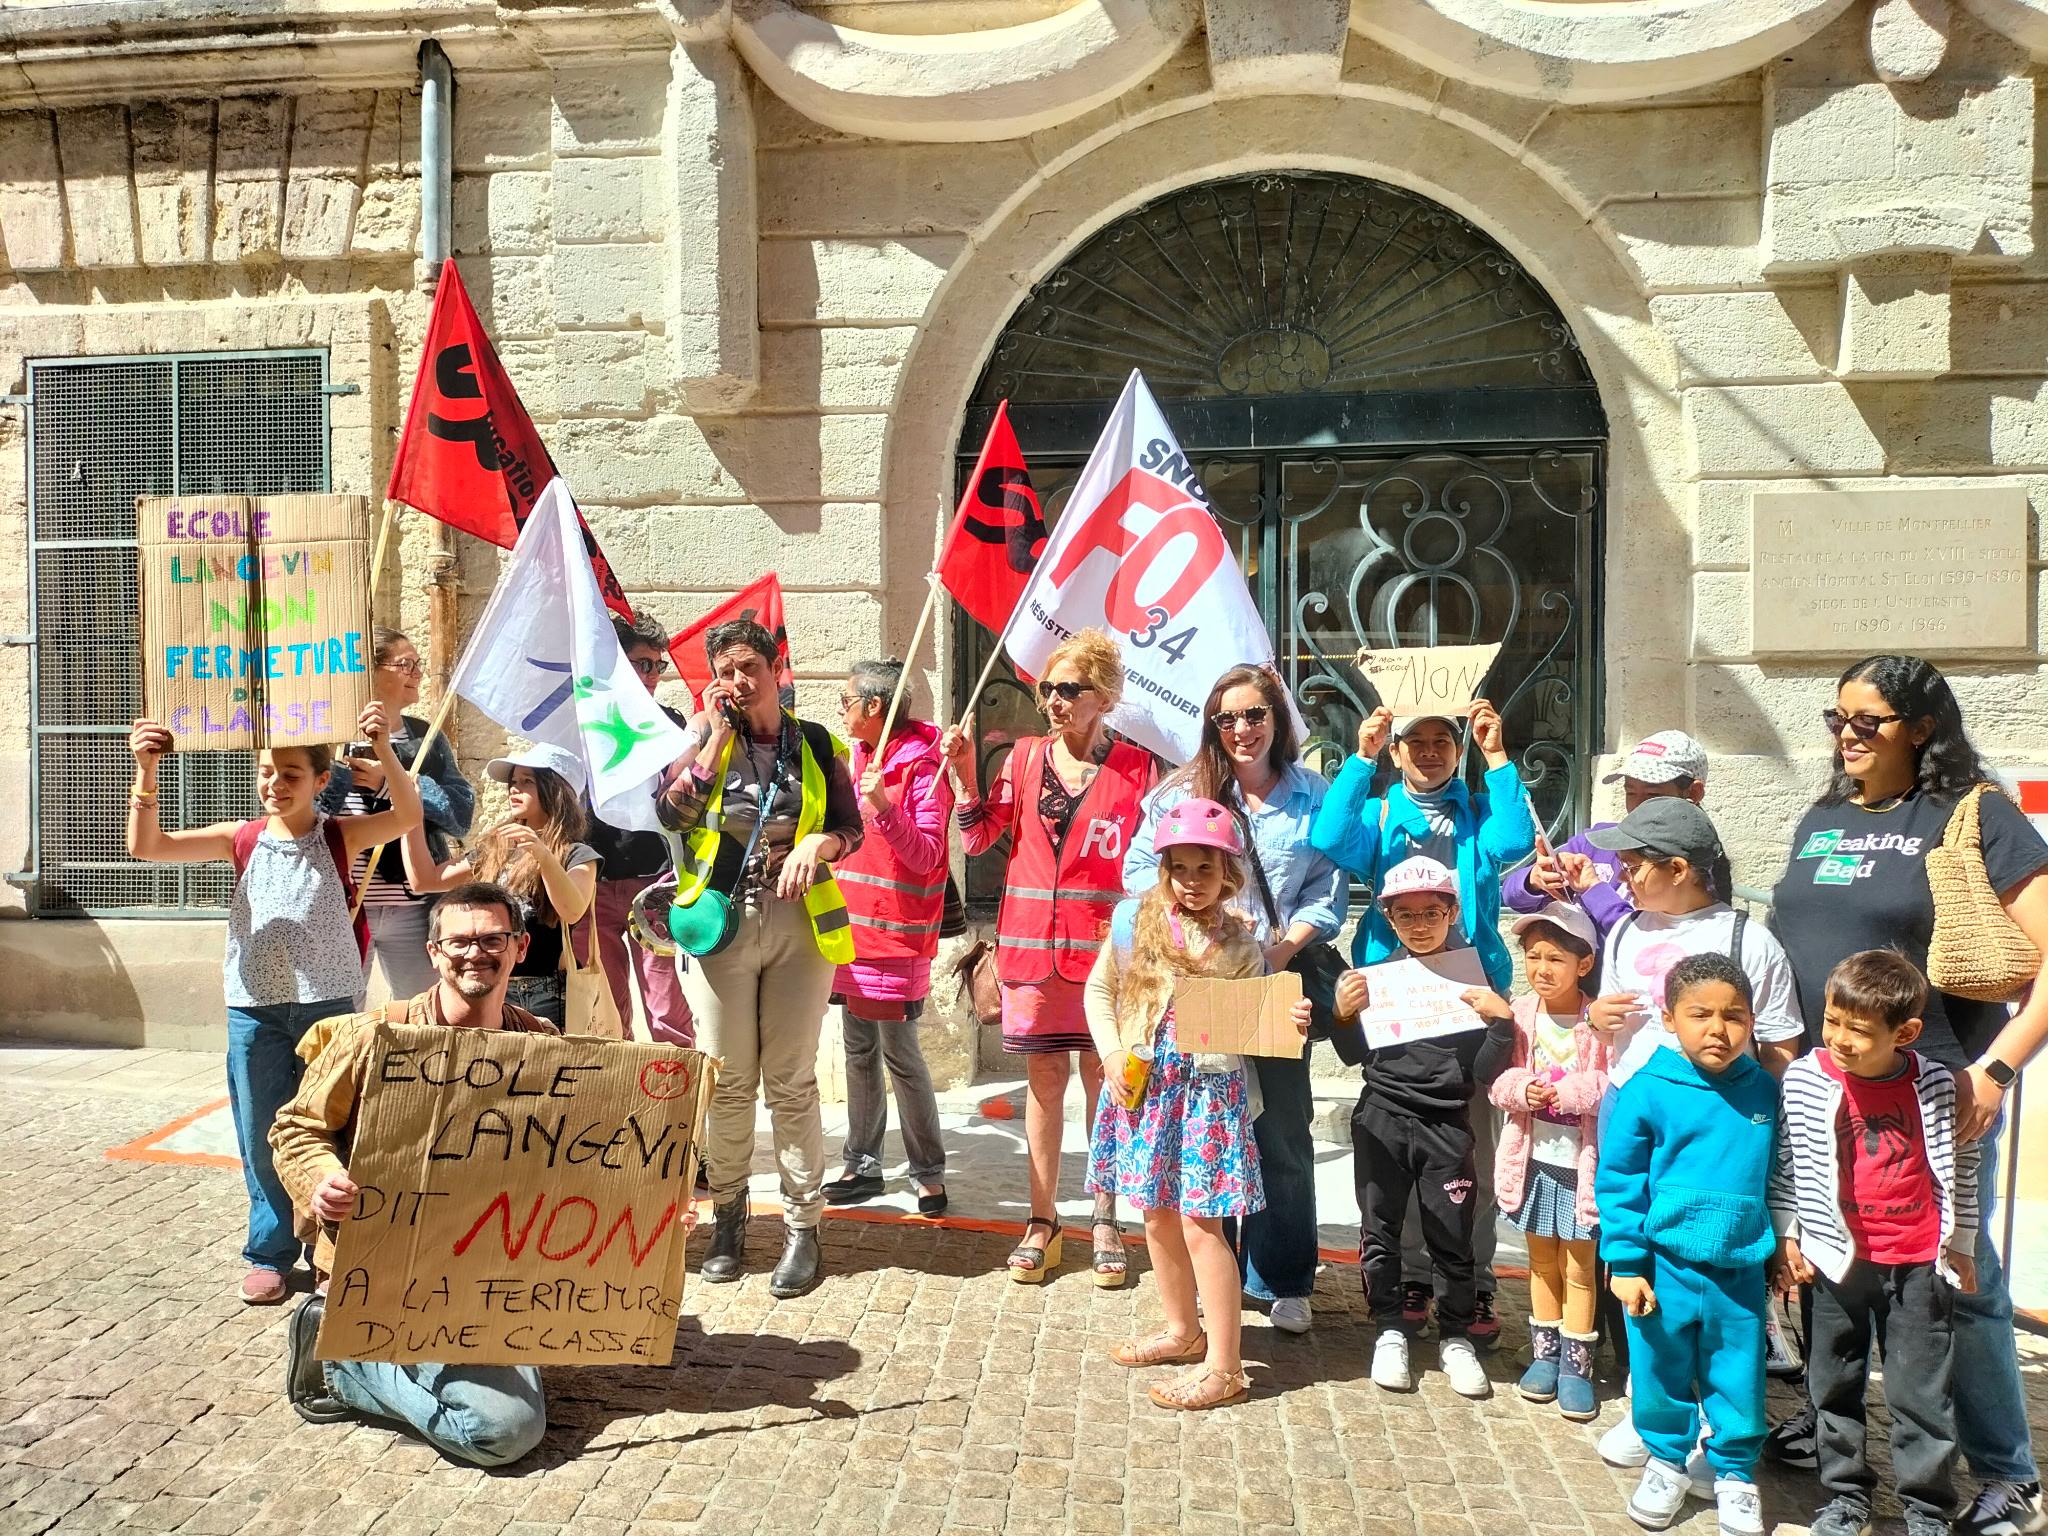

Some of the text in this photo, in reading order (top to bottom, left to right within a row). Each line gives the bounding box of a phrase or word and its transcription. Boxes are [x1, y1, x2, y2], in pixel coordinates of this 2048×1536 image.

[171, 551, 332, 583] LANGEVIN
[1050, 467, 1225, 636] FO
[210, 589, 317, 633] NON
[1029, 598, 1077, 642] RÉSISTE
[166, 632, 366, 679] FERMETURE
[1130, 607, 1199, 665] 34
[1393, 655, 1479, 709] NON
[171, 700, 332, 736] CLASSE
[1080, 818, 1121, 860] FO
[1807, 832, 1923, 856] Breaking
[1819, 860, 1876, 879] Bad
[380, 1048, 601, 1099] ECOLE
[1443, 1179, 1473, 1191] adidas
[352, 1185, 677, 1268] DIT NON
[339, 1267, 370, 1307] A
[402, 1276, 450, 1313] LA
[505, 1326, 658, 1357] CLASSE
